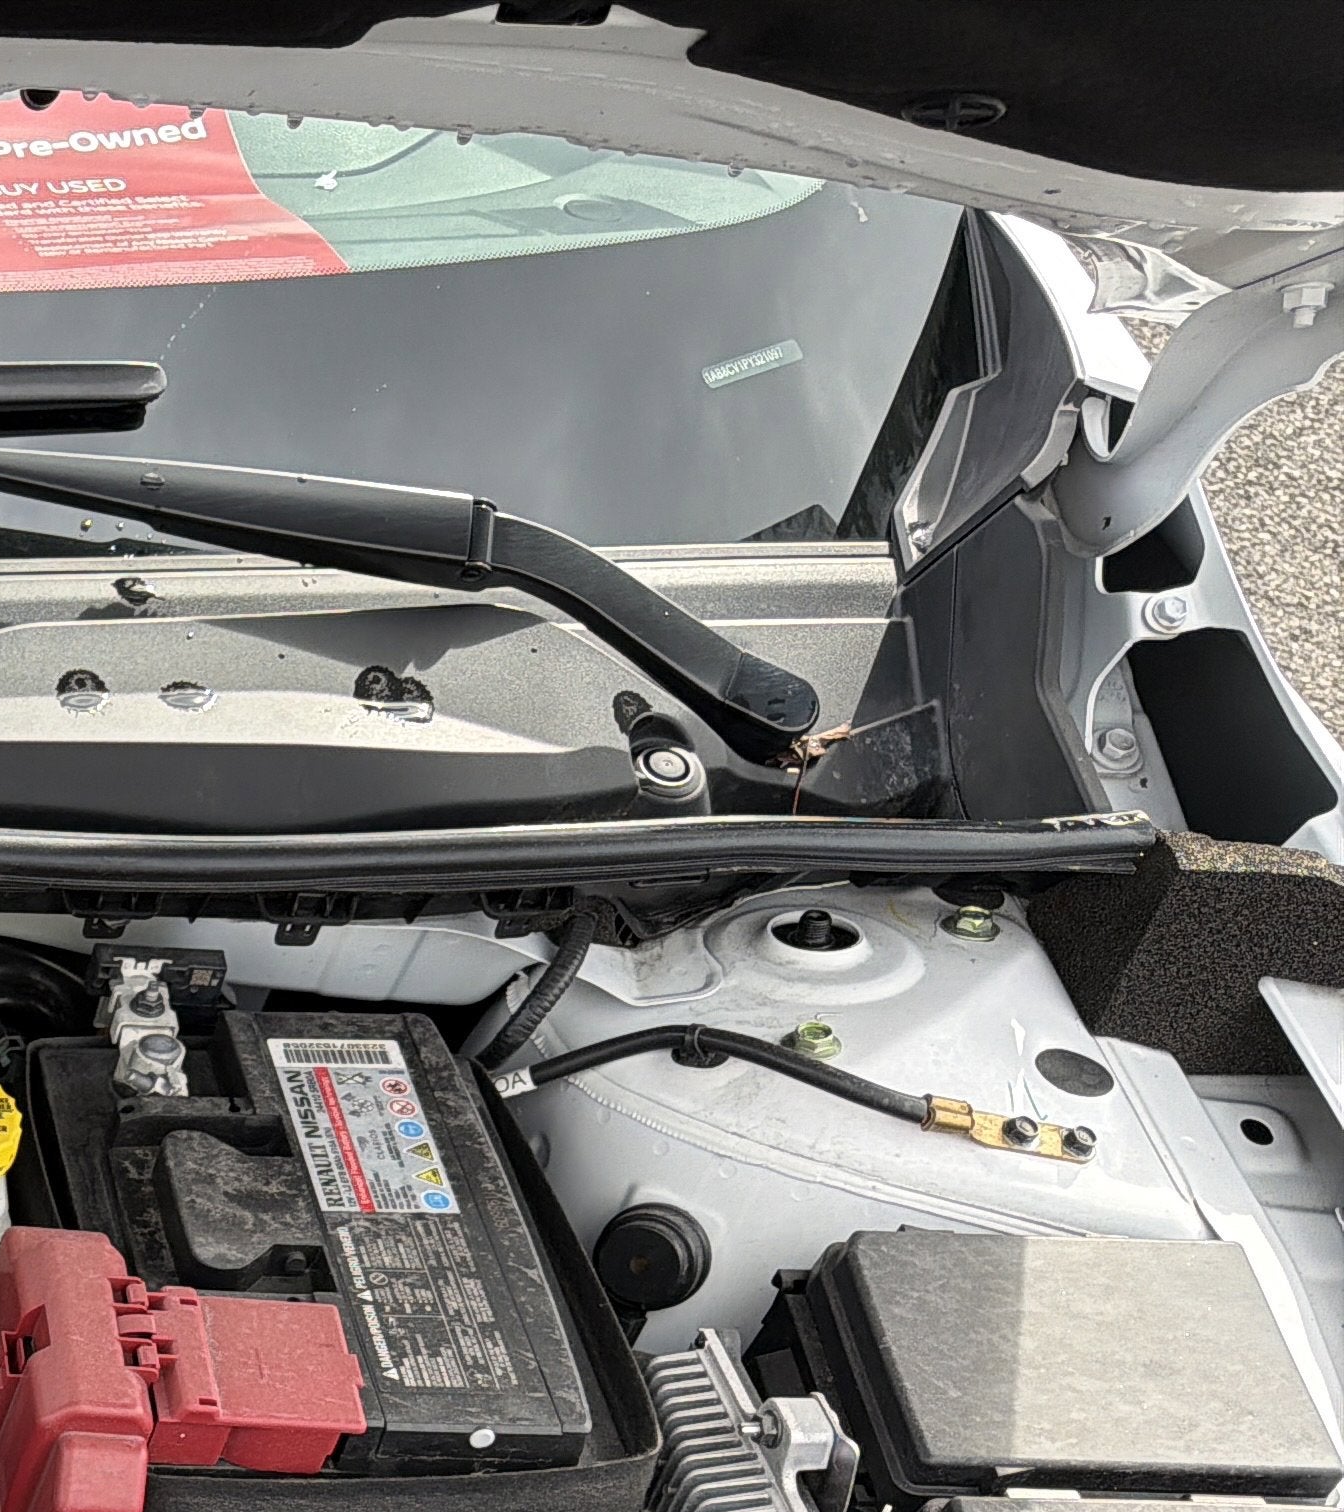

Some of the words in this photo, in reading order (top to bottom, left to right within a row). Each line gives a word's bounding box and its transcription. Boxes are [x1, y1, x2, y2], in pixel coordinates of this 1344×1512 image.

[23, 201, 55, 210] and
[59, 197, 133, 208] Certified
[47, 178, 127, 194] USED
[284, 1070, 322, 1138] NISSAN
[307, 1143, 345, 1207] RENAULT
